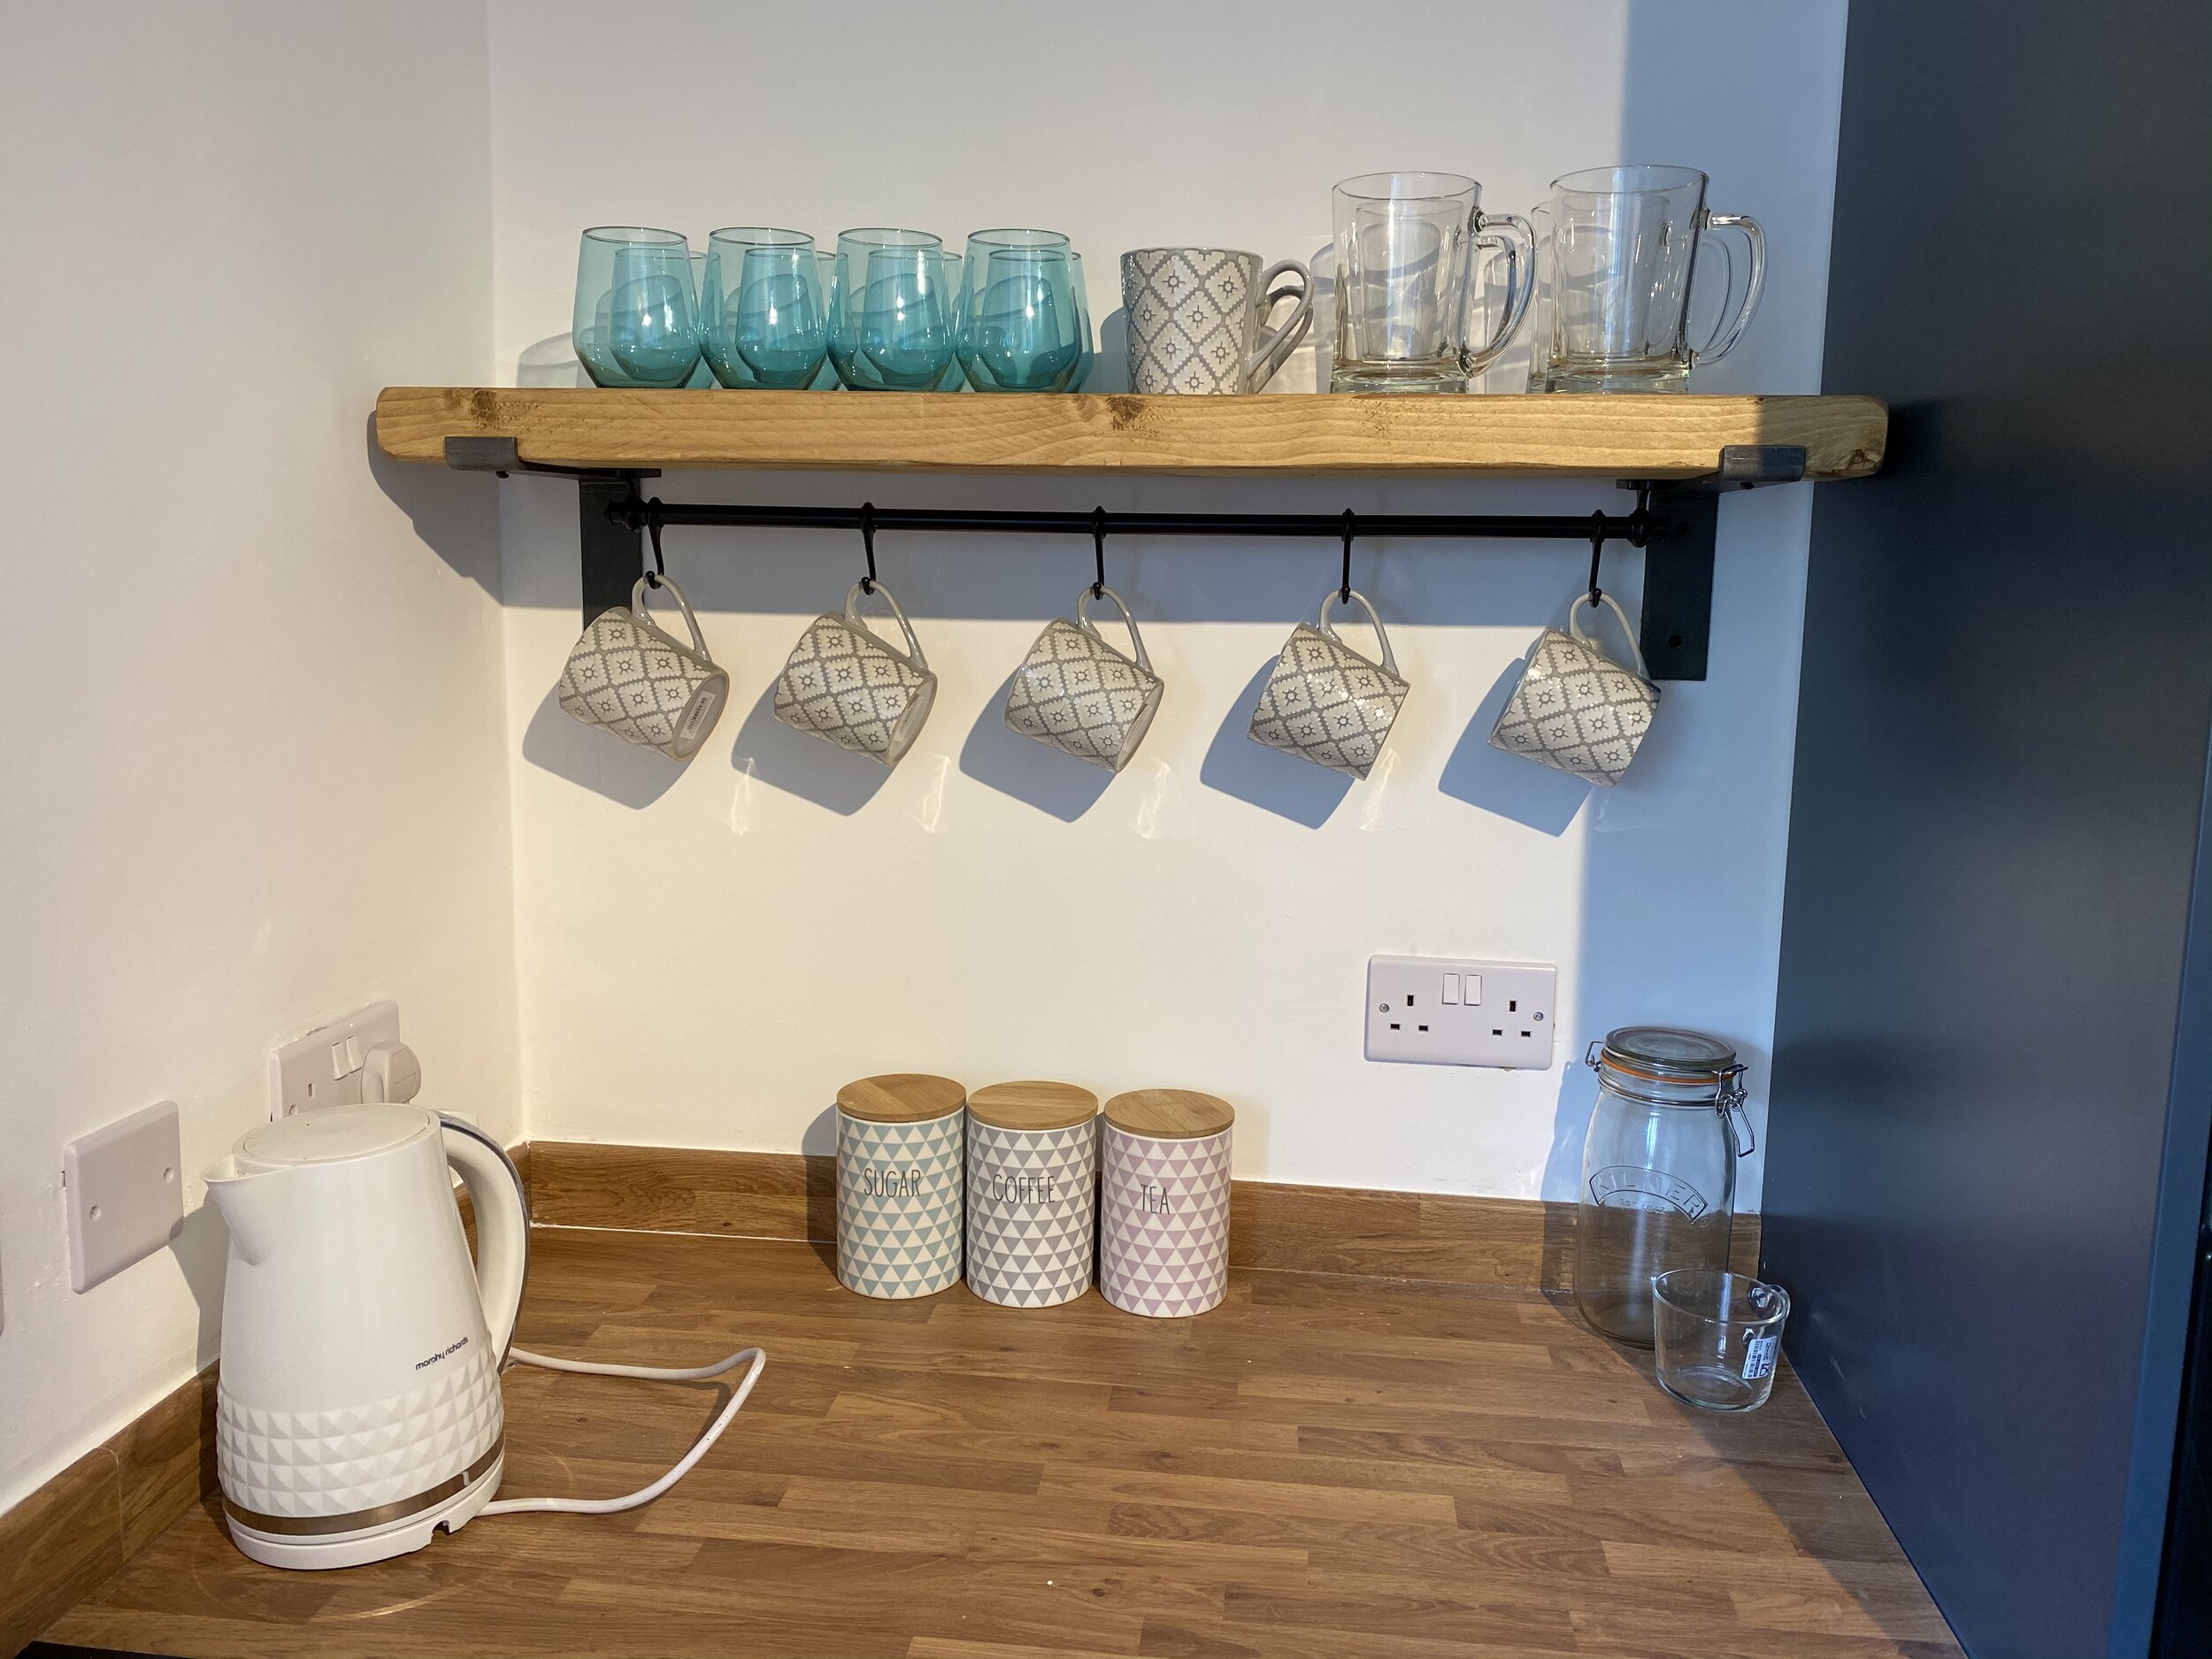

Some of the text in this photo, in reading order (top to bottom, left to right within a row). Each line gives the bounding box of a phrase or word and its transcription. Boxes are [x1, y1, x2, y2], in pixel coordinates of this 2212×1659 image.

[864, 1168, 921, 1198] SUGAR
[992, 1173, 1056, 1204] COFFEE
[1595, 1172, 1701, 1215] KILNER
[1140, 1184, 1171, 1216] TEA
[416, 1336, 468, 1371] morphy richards
